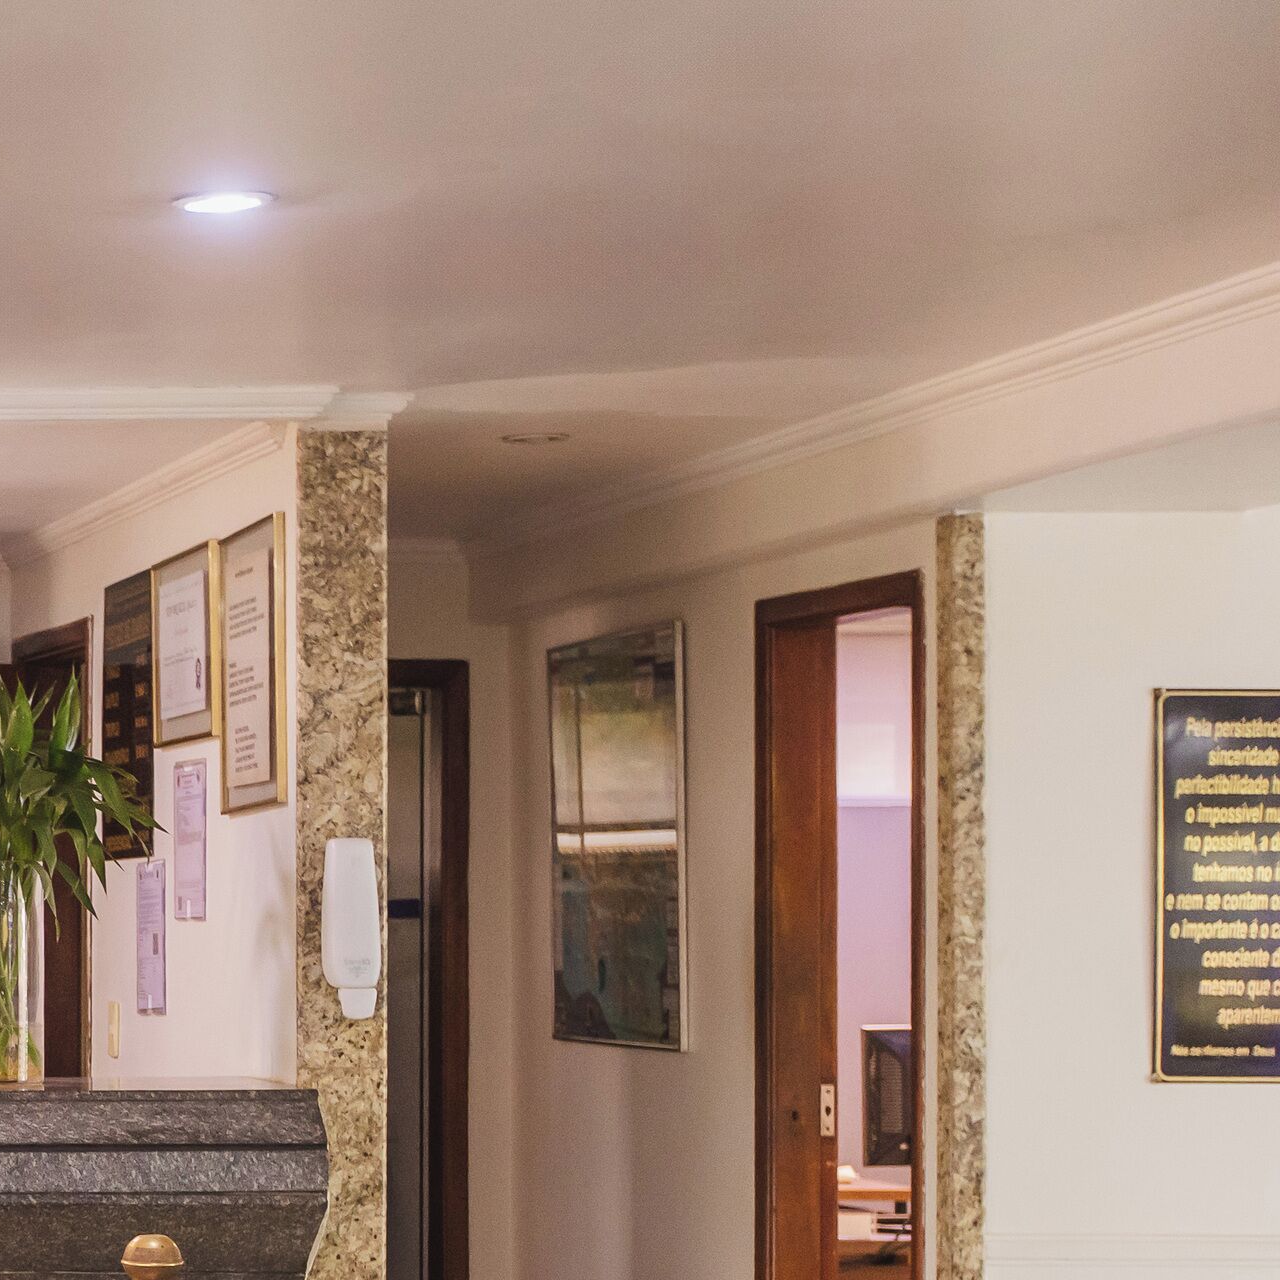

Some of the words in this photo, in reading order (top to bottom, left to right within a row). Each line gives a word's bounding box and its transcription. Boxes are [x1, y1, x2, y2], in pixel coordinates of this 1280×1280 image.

[1186, 717, 1212, 737] Pela
[1208, 745, 1279, 766] sinceridade
[1174, 774, 1269, 800] perfectibilidade
[1185, 806, 1195, 824] o
[1197, 802, 1264, 828] impossível
[1184, 835, 1201, 851] no
[1202, 831, 1257, 857] possível,
[1259, 835, 1268, 852] a
[1193, 861, 1253, 882] tenhamos
[1255, 865, 1272, 882] no
[1165, 893, 1175, 911] e
[1176, 893, 1203, 910] nem
[1204, 893, 1221, 911] se
[1222, 891, 1269, 911] contam
[1169, 922, 1180, 939] o
[1181, 918, 1248, 944] importante
[1248, 918, 1258, 939] é
[1259, 922, 1269, 939] o
[1201, 947, 1270, 968] consciente
[1199, 978, 1245, 996] mesmo
[1246, 978, 1271, 1002] que
